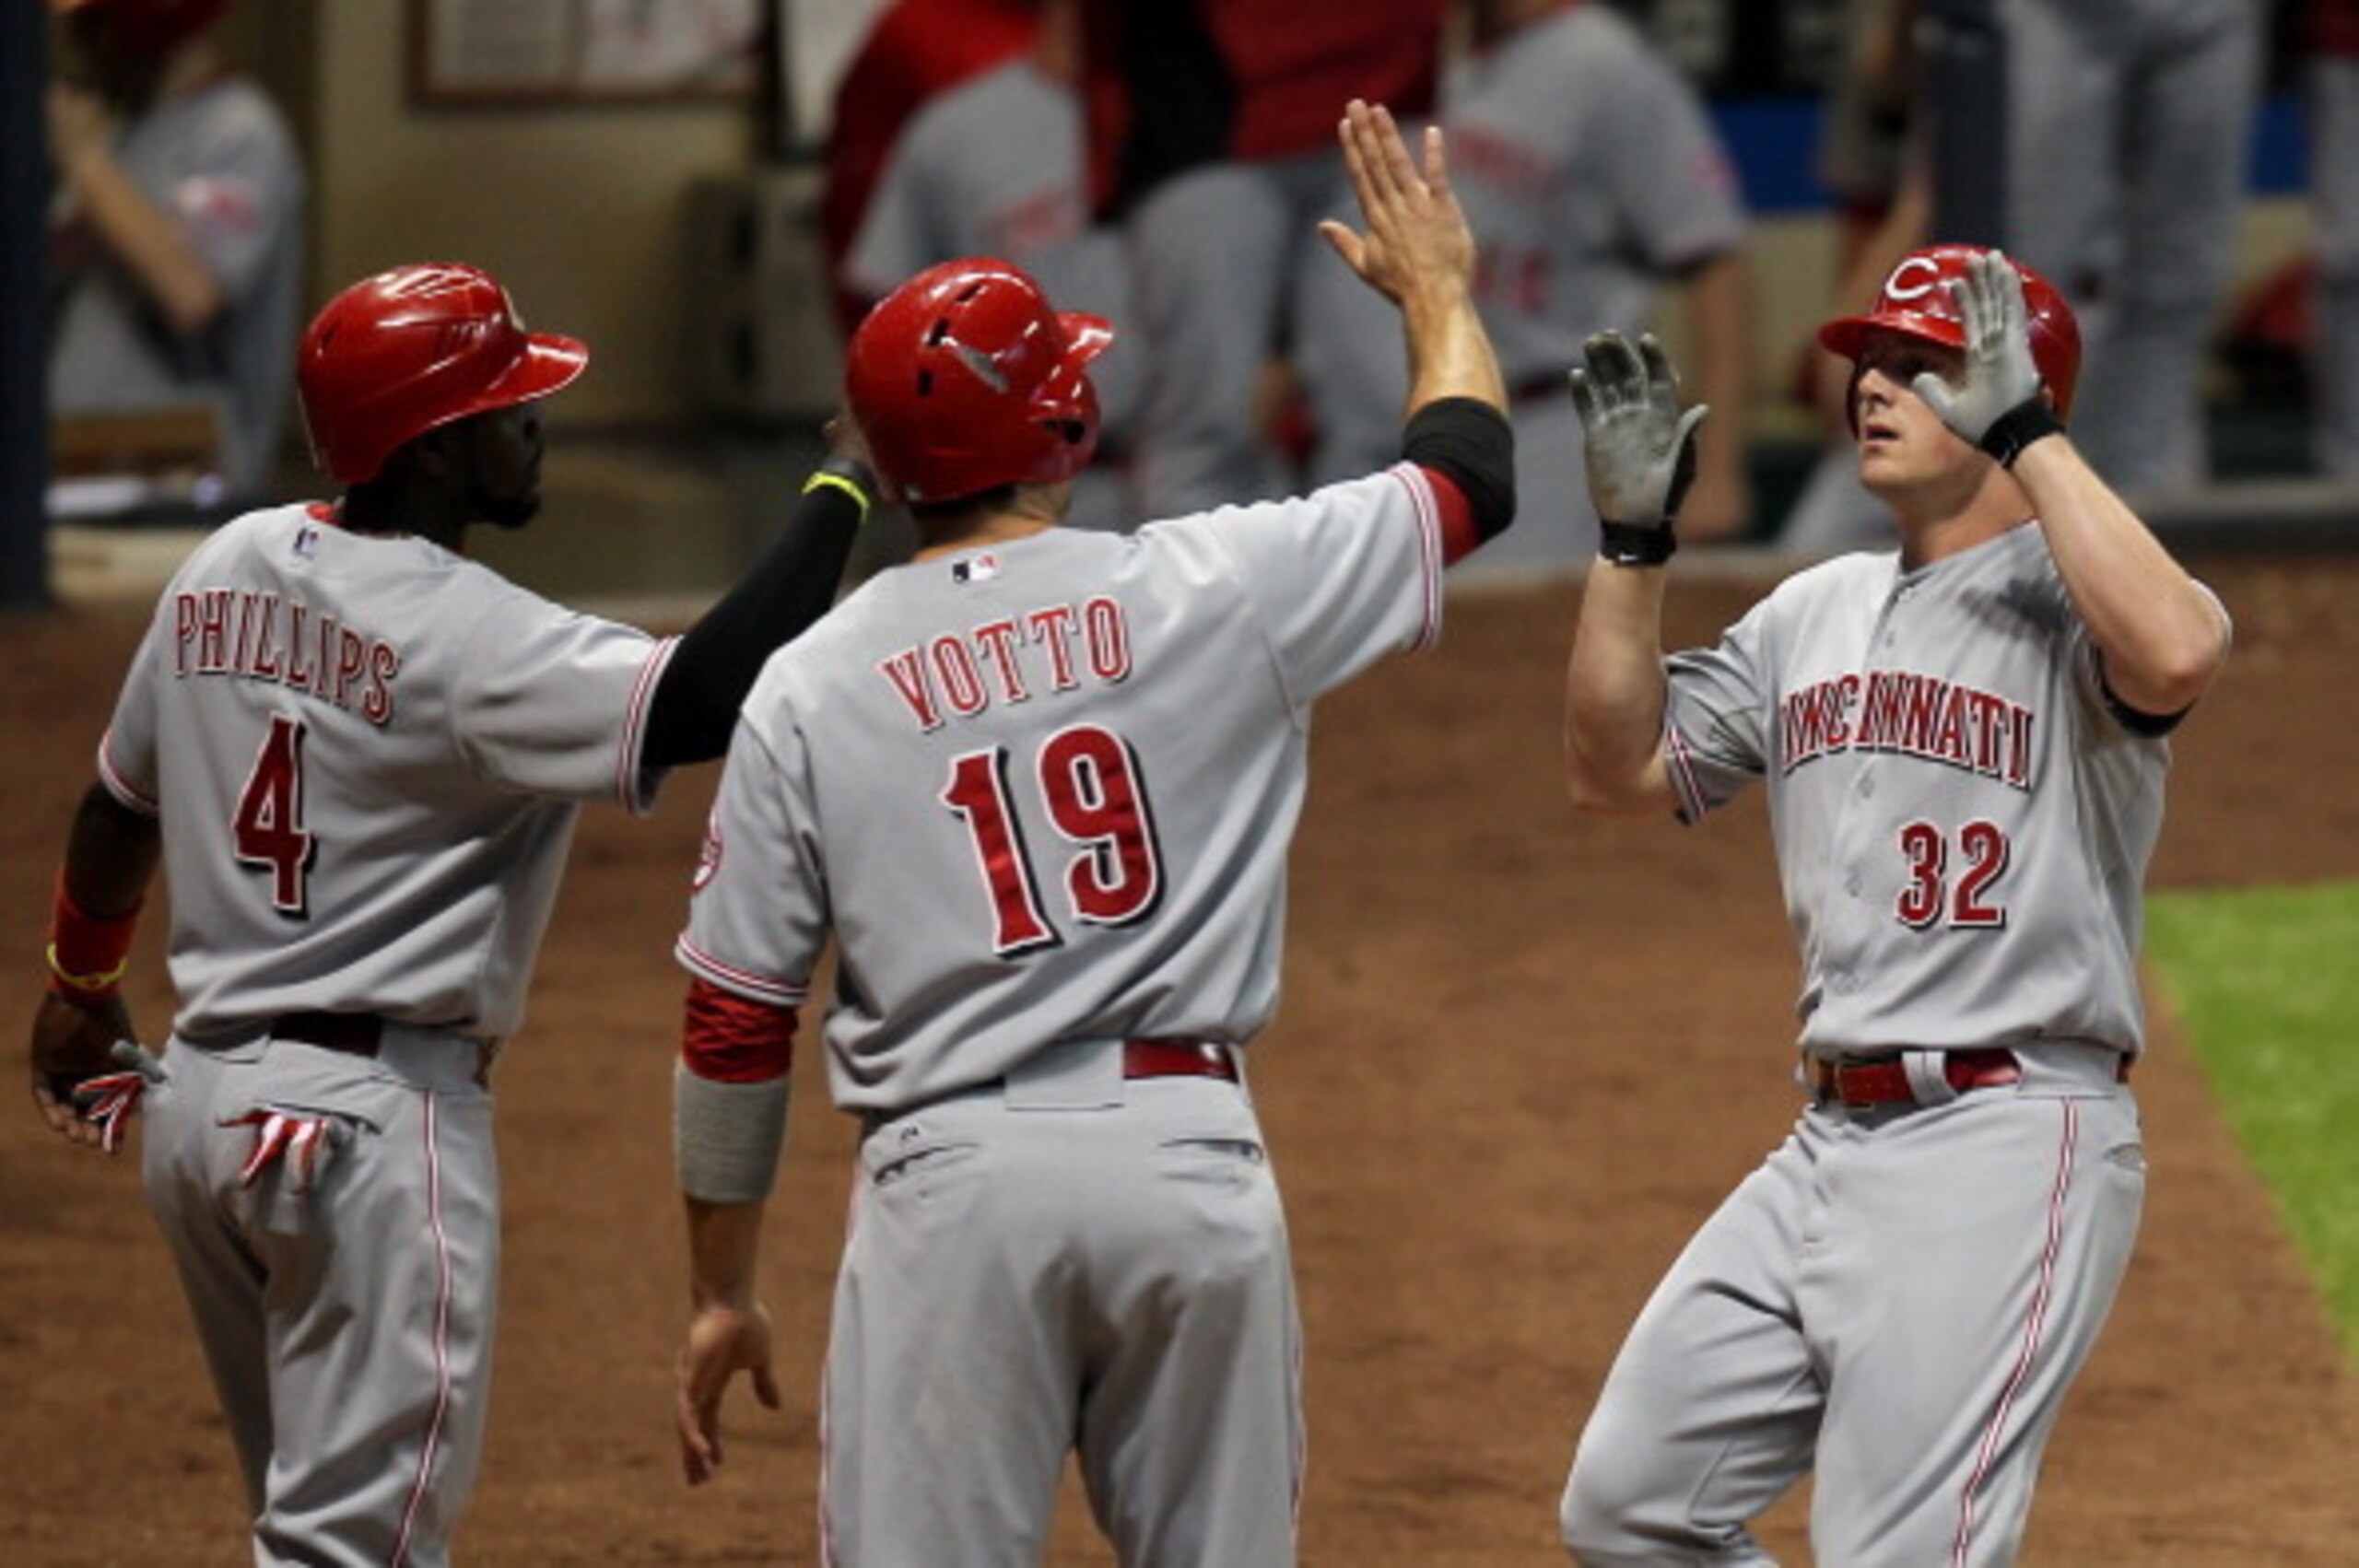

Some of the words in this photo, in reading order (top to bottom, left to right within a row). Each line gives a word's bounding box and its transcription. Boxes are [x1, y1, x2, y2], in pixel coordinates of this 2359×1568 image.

[1885, 257, 1939, 299] C
[175, 588, 401, 726] PHILLIPS
[874, 595, 1132, 733] VOTTO
[1780, 670, 2033, 793] INCINNATI
[230, 709, 319, 921] 4
[939, 721, 1166, 959] 19
[1895, 817, 2010, 931] 32
